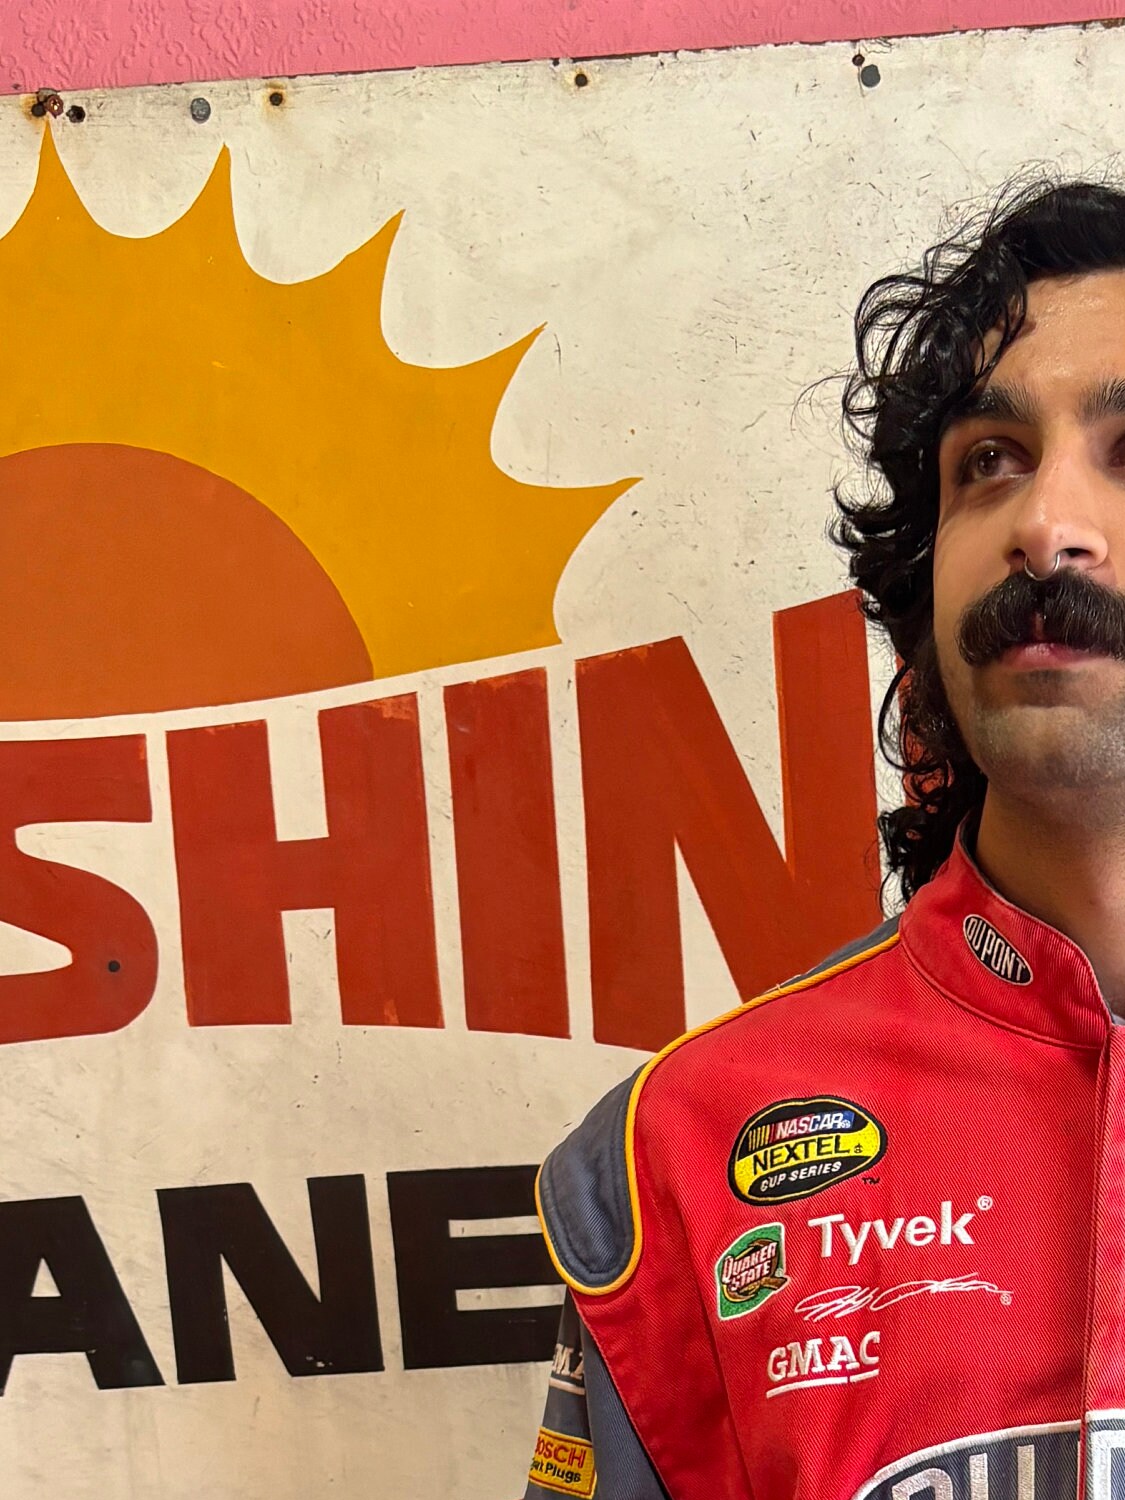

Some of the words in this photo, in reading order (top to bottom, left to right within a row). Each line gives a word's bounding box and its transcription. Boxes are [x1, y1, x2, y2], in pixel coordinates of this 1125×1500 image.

[0, 587, 952, 1055] SHIN
[775, 1112, 843, 1140] NASCAR
[752, 1134, 850, 1176] NEXTEL
[760, 1172, 787, 1192] CUP
[788, 1160, 842, 1182] SERIES
[808, 1200, 975, 1266] Tyvek
[722, 1241, 778, 1284] QUAKER
[728, 1260, 771, 1292] STATE
[766, 1331, 880, 1382] GMAC
[535, 1436, 587, 1469] OSCH
[544, 1461, 582, 1484] Plugs
